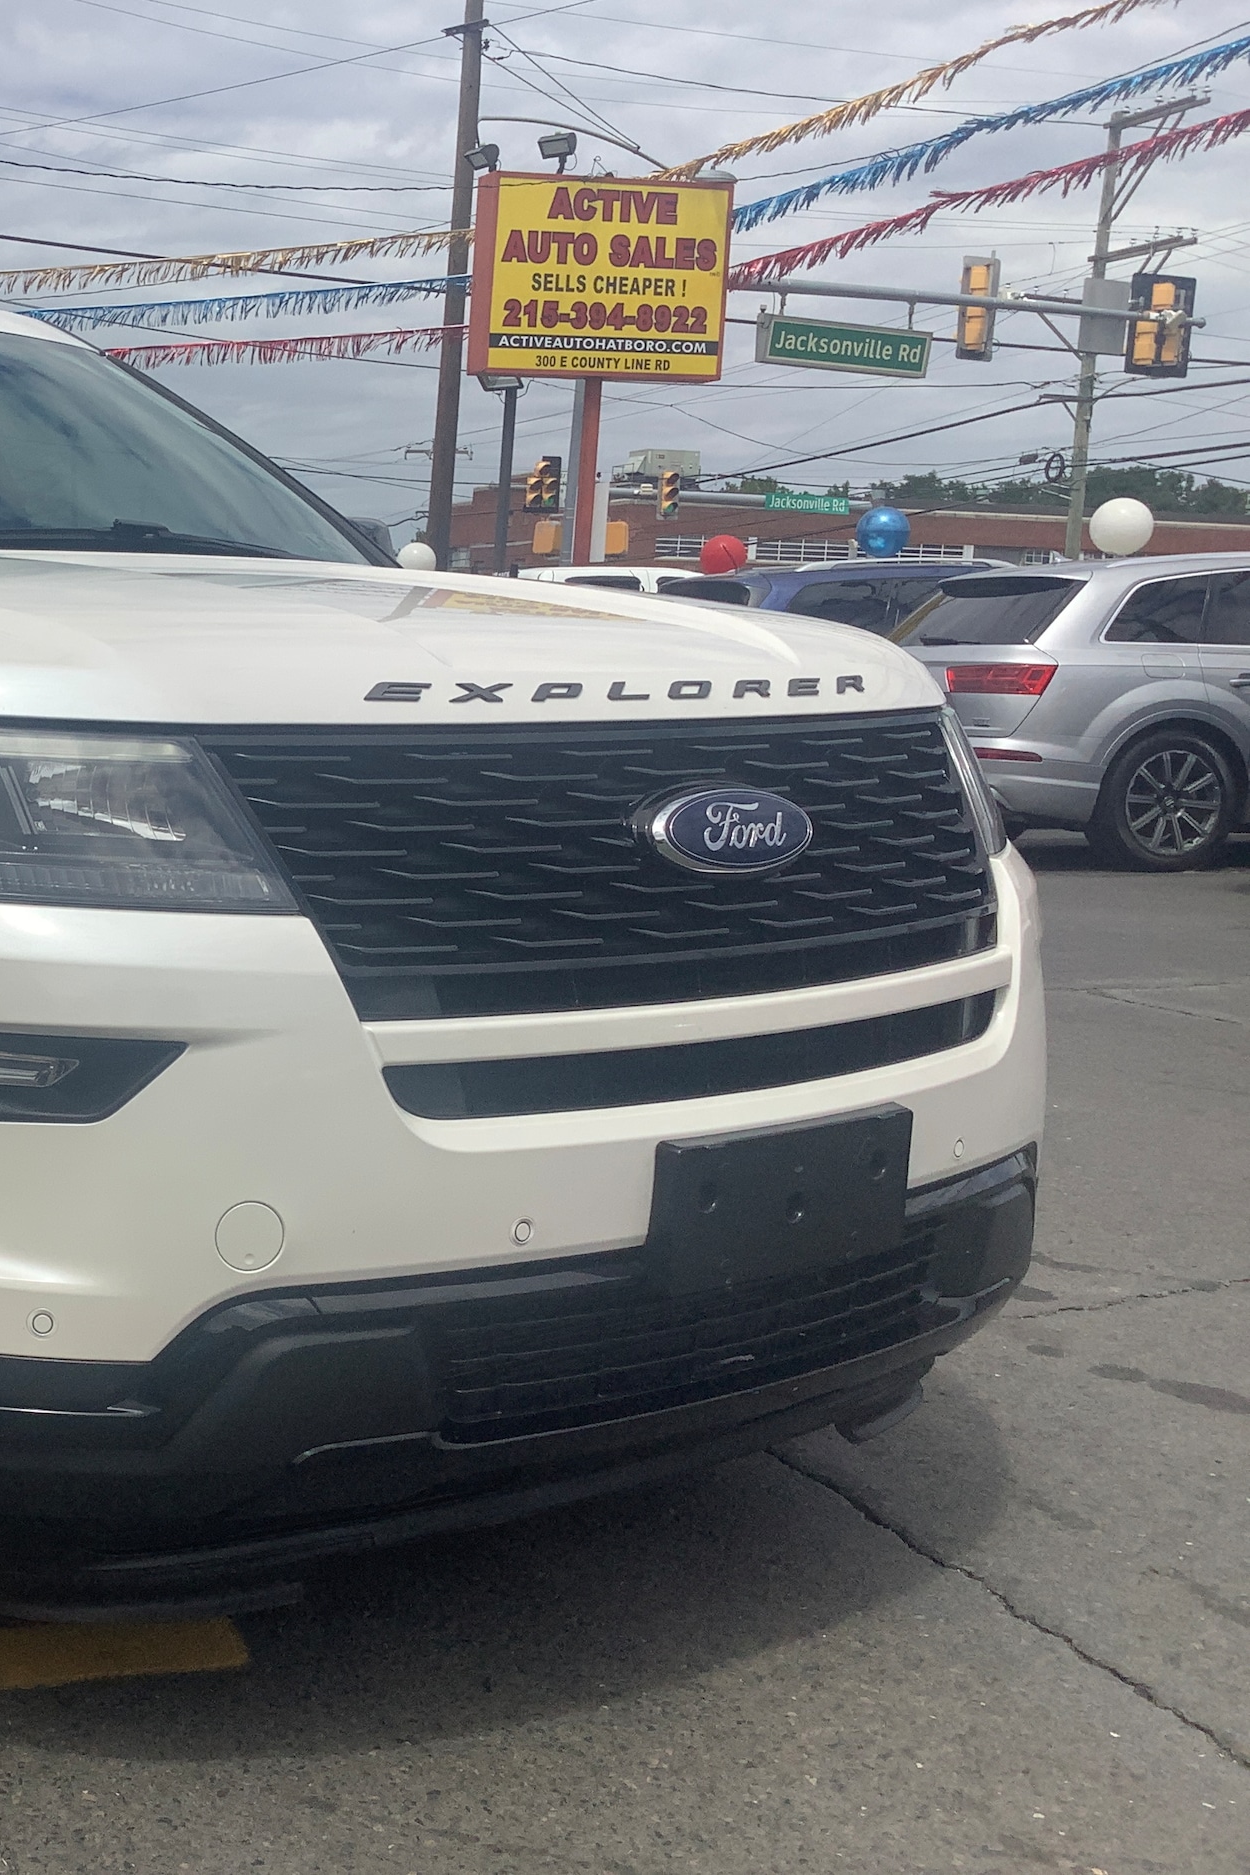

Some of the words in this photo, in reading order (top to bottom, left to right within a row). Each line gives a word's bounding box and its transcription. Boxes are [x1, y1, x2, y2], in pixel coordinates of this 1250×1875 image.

[547, 186, 679, 225] ACTIVE
[501, 230, 598, 266] AUTO
[608, 234, 717, 272] SALES
[531, 273, 586, 293] SELLS
[593, 275, 675, 297] CHEAPER
[502, 299, 708, 334] 215-394-8922
[498, 335, 707, 354] ACTIVEAUTOHATBORO.COM
[774, 330, 893, 361] Jacksonville
[898, 344, 922, 364] Rd
[535, 355, 556, 368] 300
[560, 356, 567, 368] E
[571, 356, 621, 370] COUNTY
[624, 358, 651, 370] LINE
[655, 359, 671, 371] RD
[769, 495, 830, 511] Jacksonville
[832, 499, 845, 512] Rd
[363, 674, 865, 703] EXPLORER
[703, 801, 787, 852] Ford
